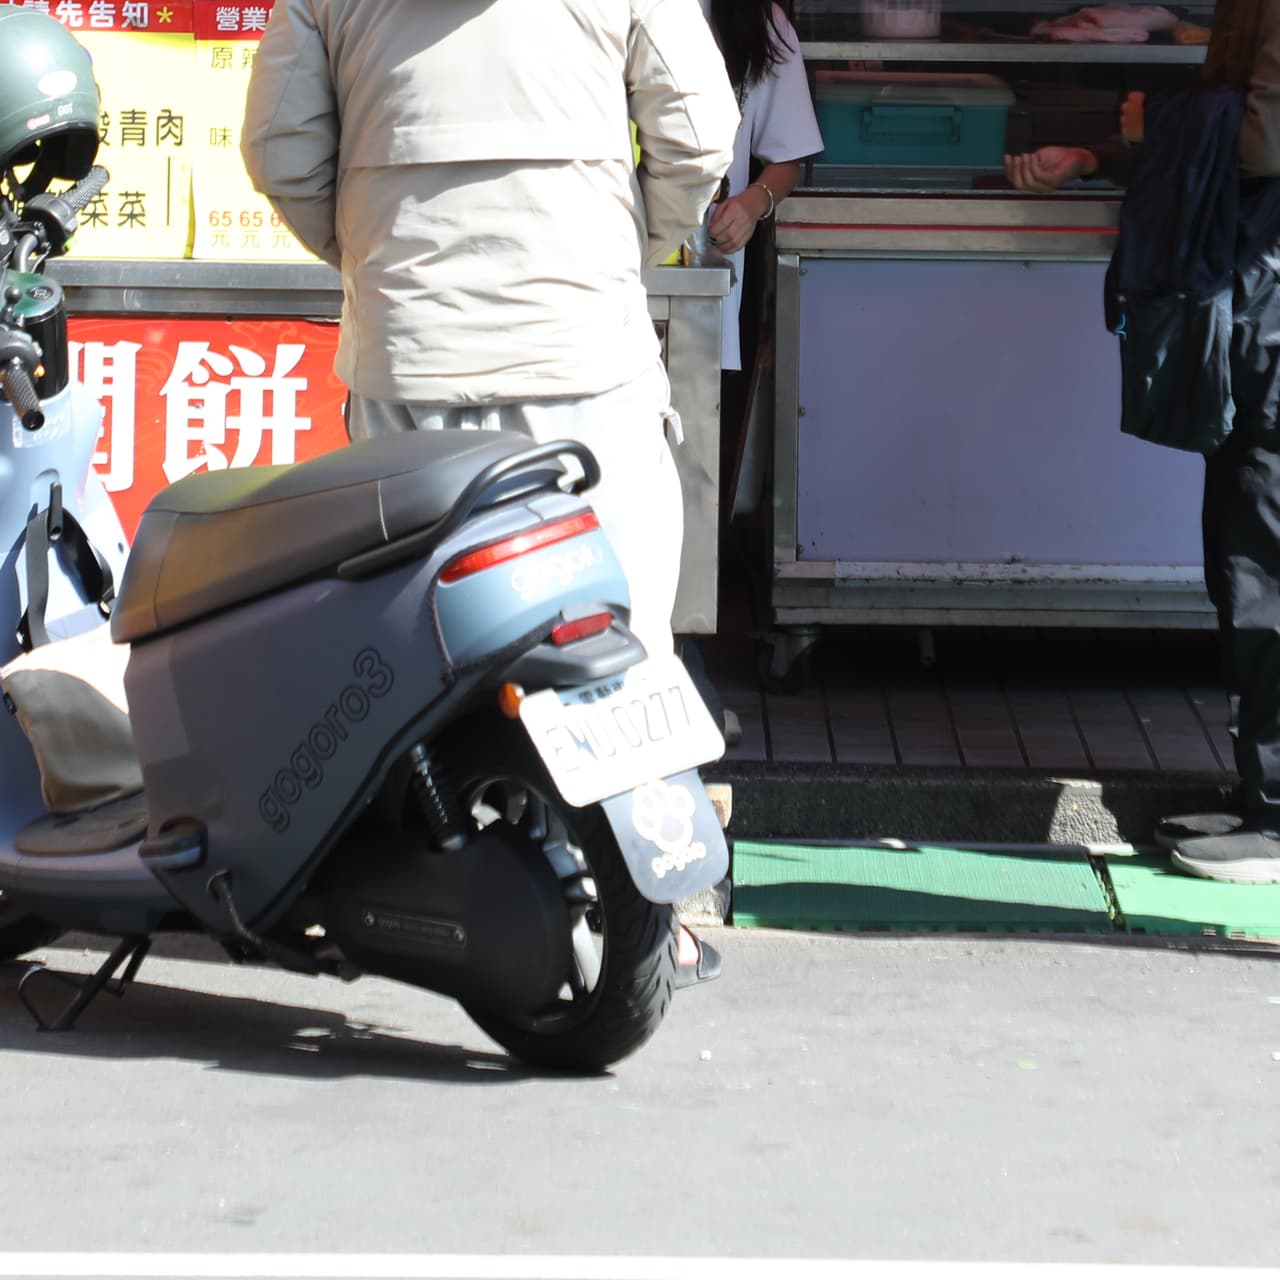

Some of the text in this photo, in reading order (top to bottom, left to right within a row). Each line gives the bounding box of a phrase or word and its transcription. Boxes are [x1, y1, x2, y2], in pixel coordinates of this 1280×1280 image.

[215, 5, 276, 33] 營業
[208, 210, 232, 227] 65
[239, 210, 263, 227] 65
[258, 646, 396, 834] gogoro3
[650, 839, 707, 880] gogoro
